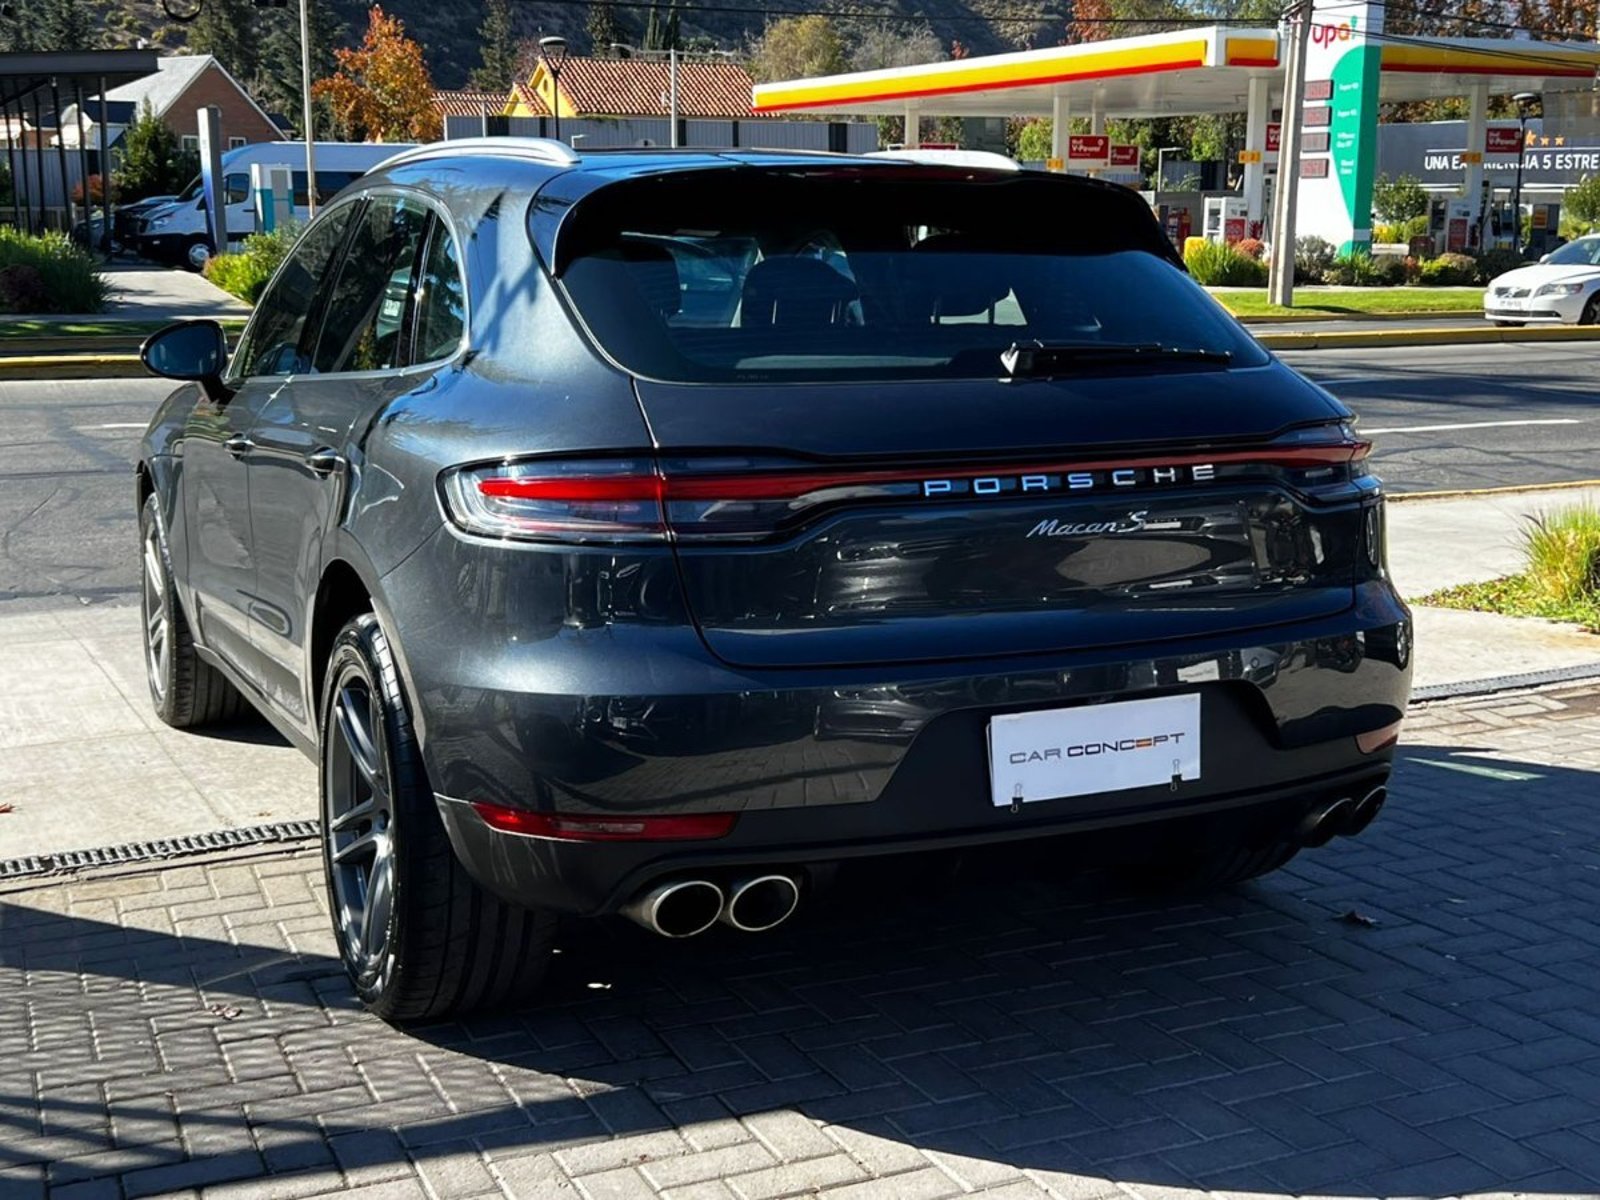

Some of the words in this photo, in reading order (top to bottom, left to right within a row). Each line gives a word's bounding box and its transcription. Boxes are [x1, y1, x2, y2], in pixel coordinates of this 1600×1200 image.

[1424, 155, 1449, 170] UNA
[1542, 154, 1552, 170] 5
[1555, 154, 1599, 170] ESTRE
[923, 464, 1215, 497] PORSCHE
[1026, 518, 1117, 538] Macan
[1117, 510, 1149, 534] S
[1009, 748, 1062, 765] CAR
[1067, 732, 1185, 757] CONCEPT
